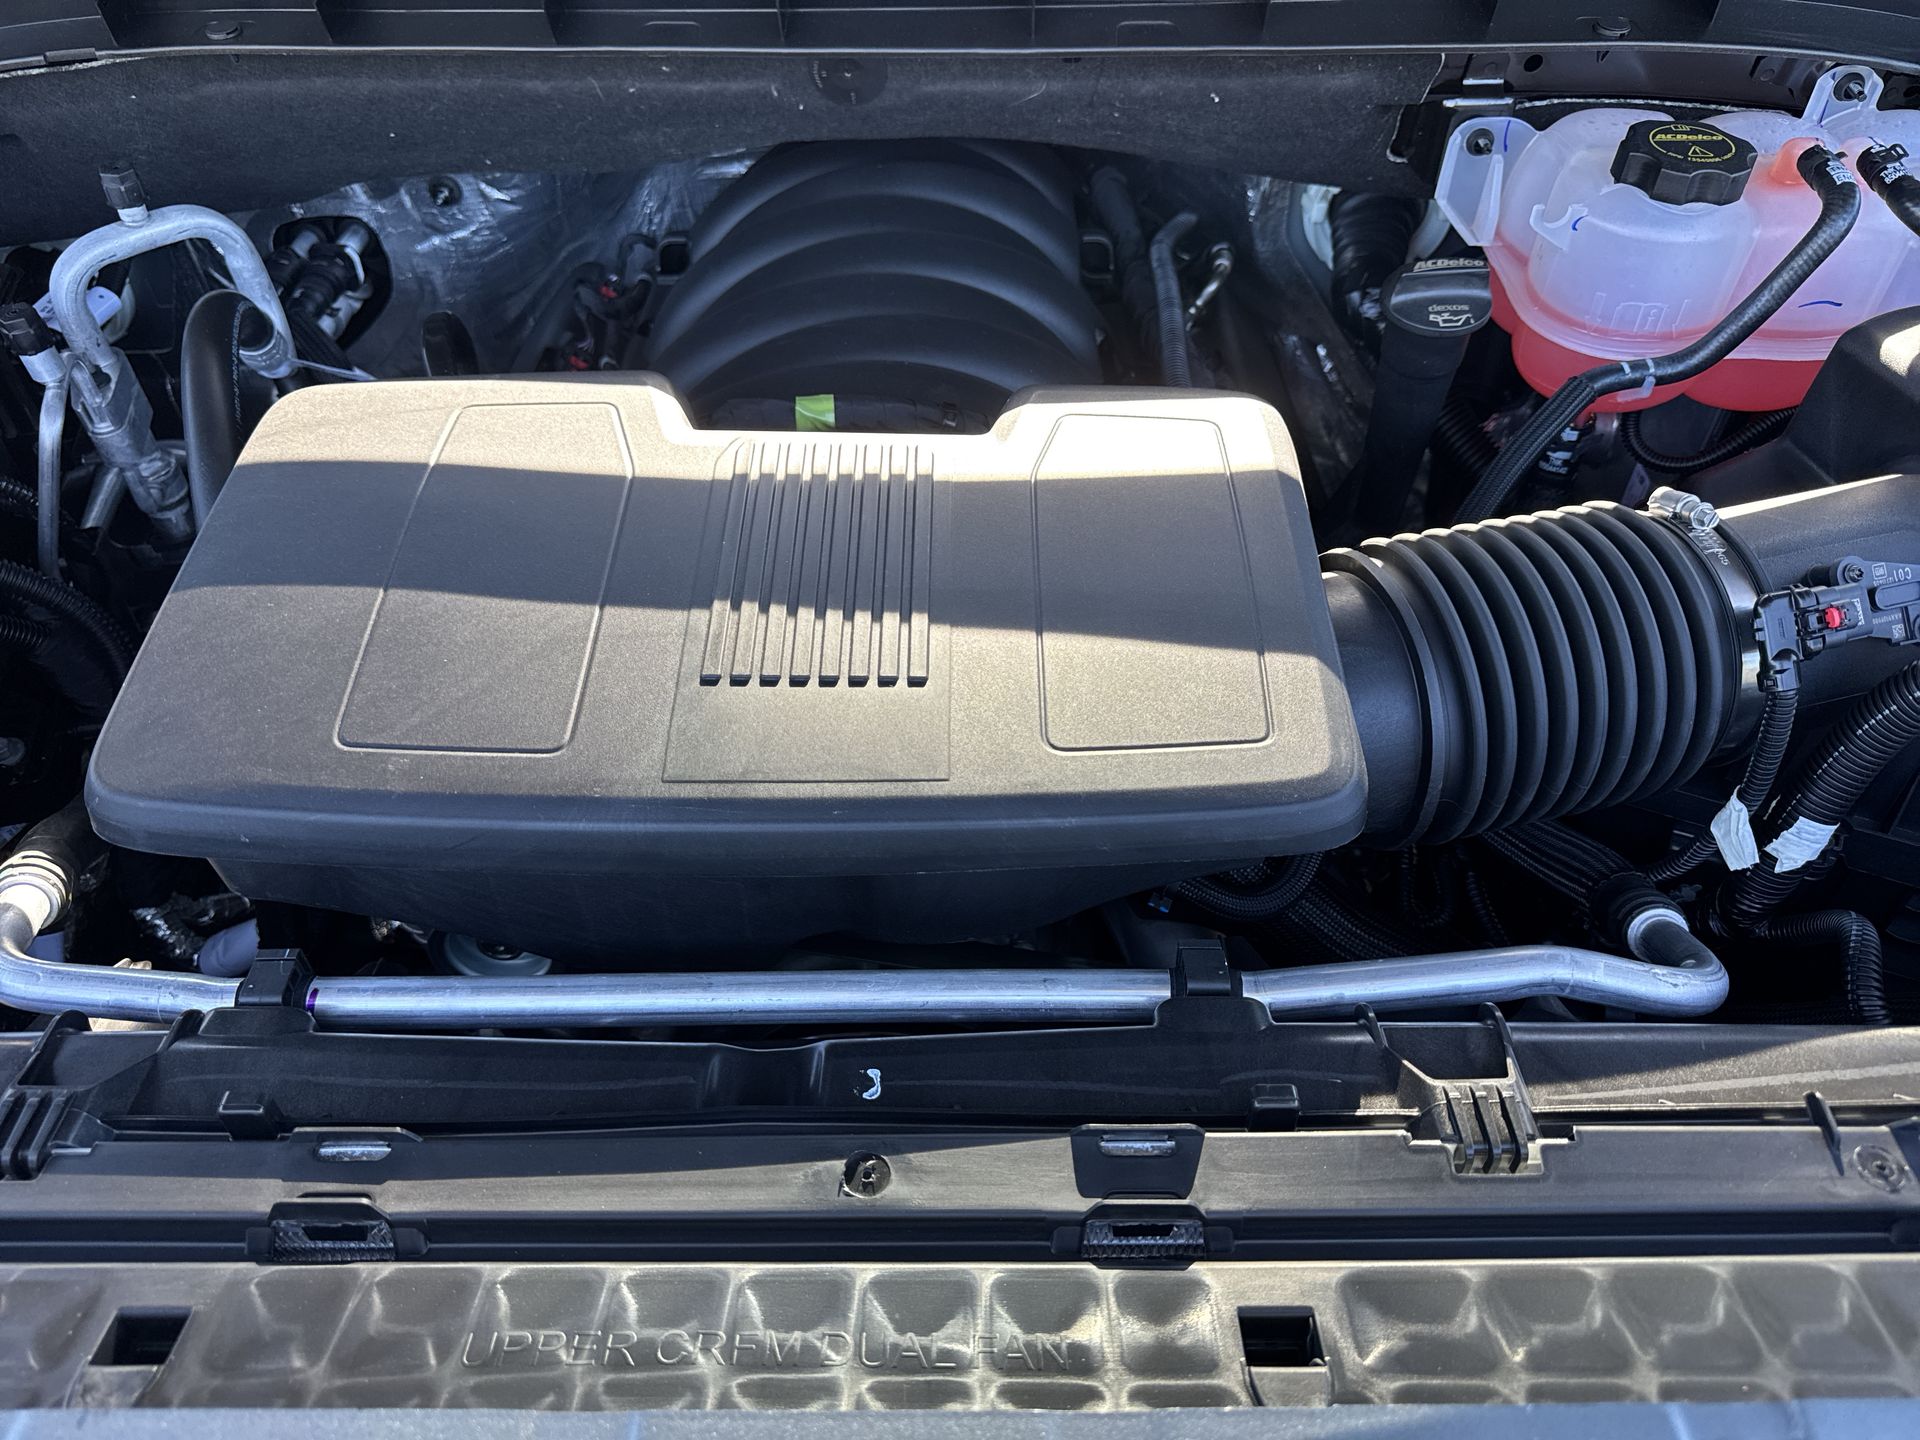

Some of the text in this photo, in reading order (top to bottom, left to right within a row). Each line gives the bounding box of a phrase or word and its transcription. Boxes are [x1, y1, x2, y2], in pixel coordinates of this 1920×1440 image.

[1654, 133, 1724, 142] ACDelco
[1413, 258, 1484, 271] ACDelco
[1427, 304, 1470, 312] dexos
[462, 1329, 638, 1368] UPPER
[819, 1329, 957, 1369] DUAL
[972, 1331, 1071, 1371] FAN
